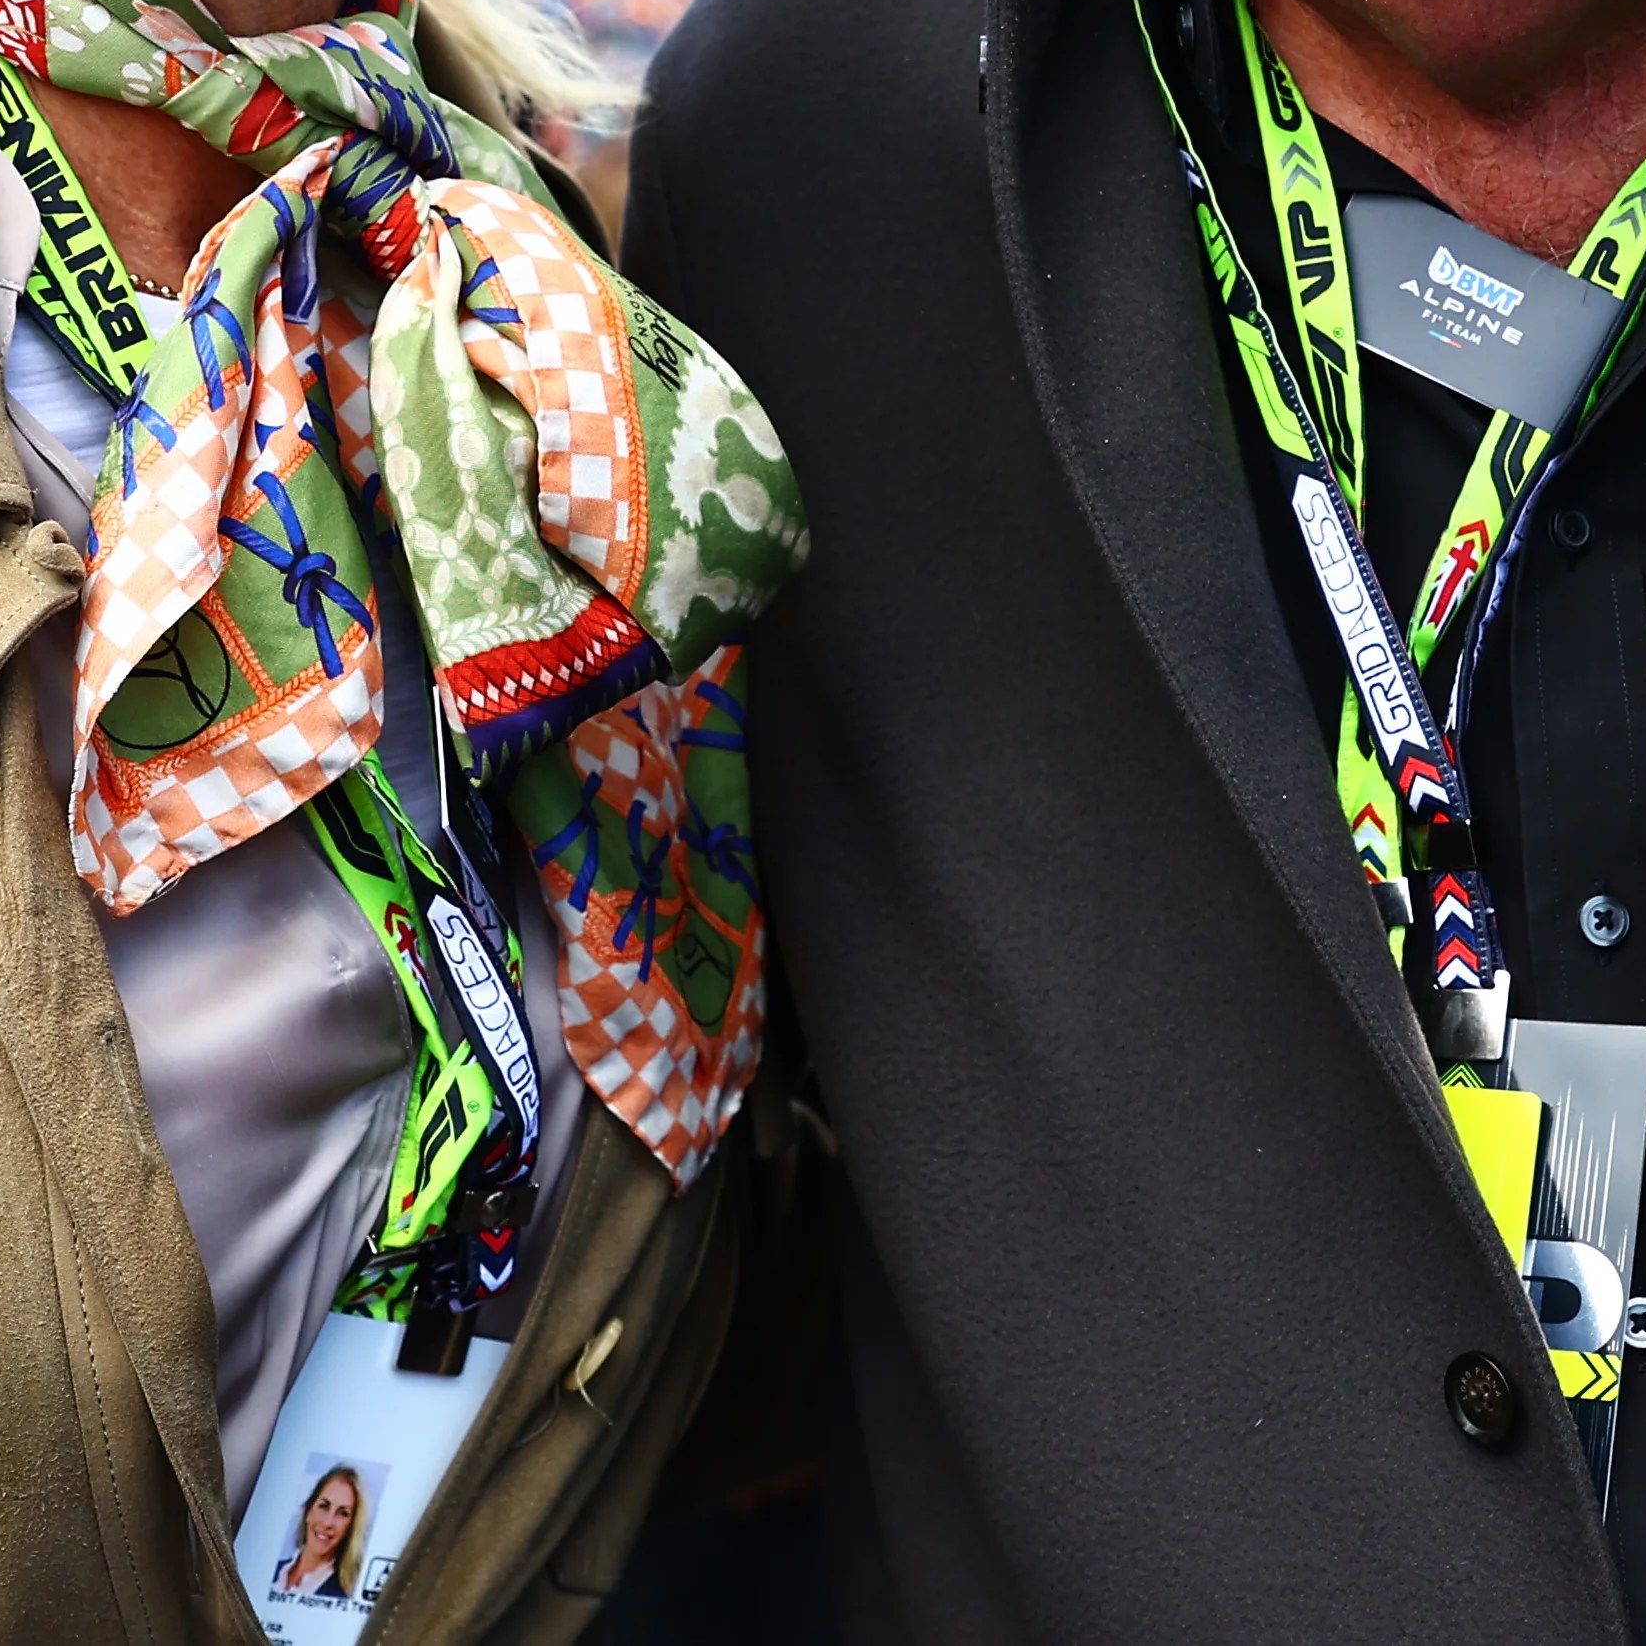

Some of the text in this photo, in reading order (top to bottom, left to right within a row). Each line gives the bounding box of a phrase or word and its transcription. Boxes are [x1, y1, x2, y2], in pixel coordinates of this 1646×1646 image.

[1287, 200, 1336, 308] VIP
[1398, 279, 1525, 346] ALPINE
[1453, 265, 1523, 315] BWT
[1445, 319, 1483, 346] TEAM
[1297, 492, 1412, 735] GRID ACCESS
[432, 914, 521, 1056] ACCESS
[268, 1590, 296, 1603] BWT
[298, 1595, 333, 1609] Alpine
